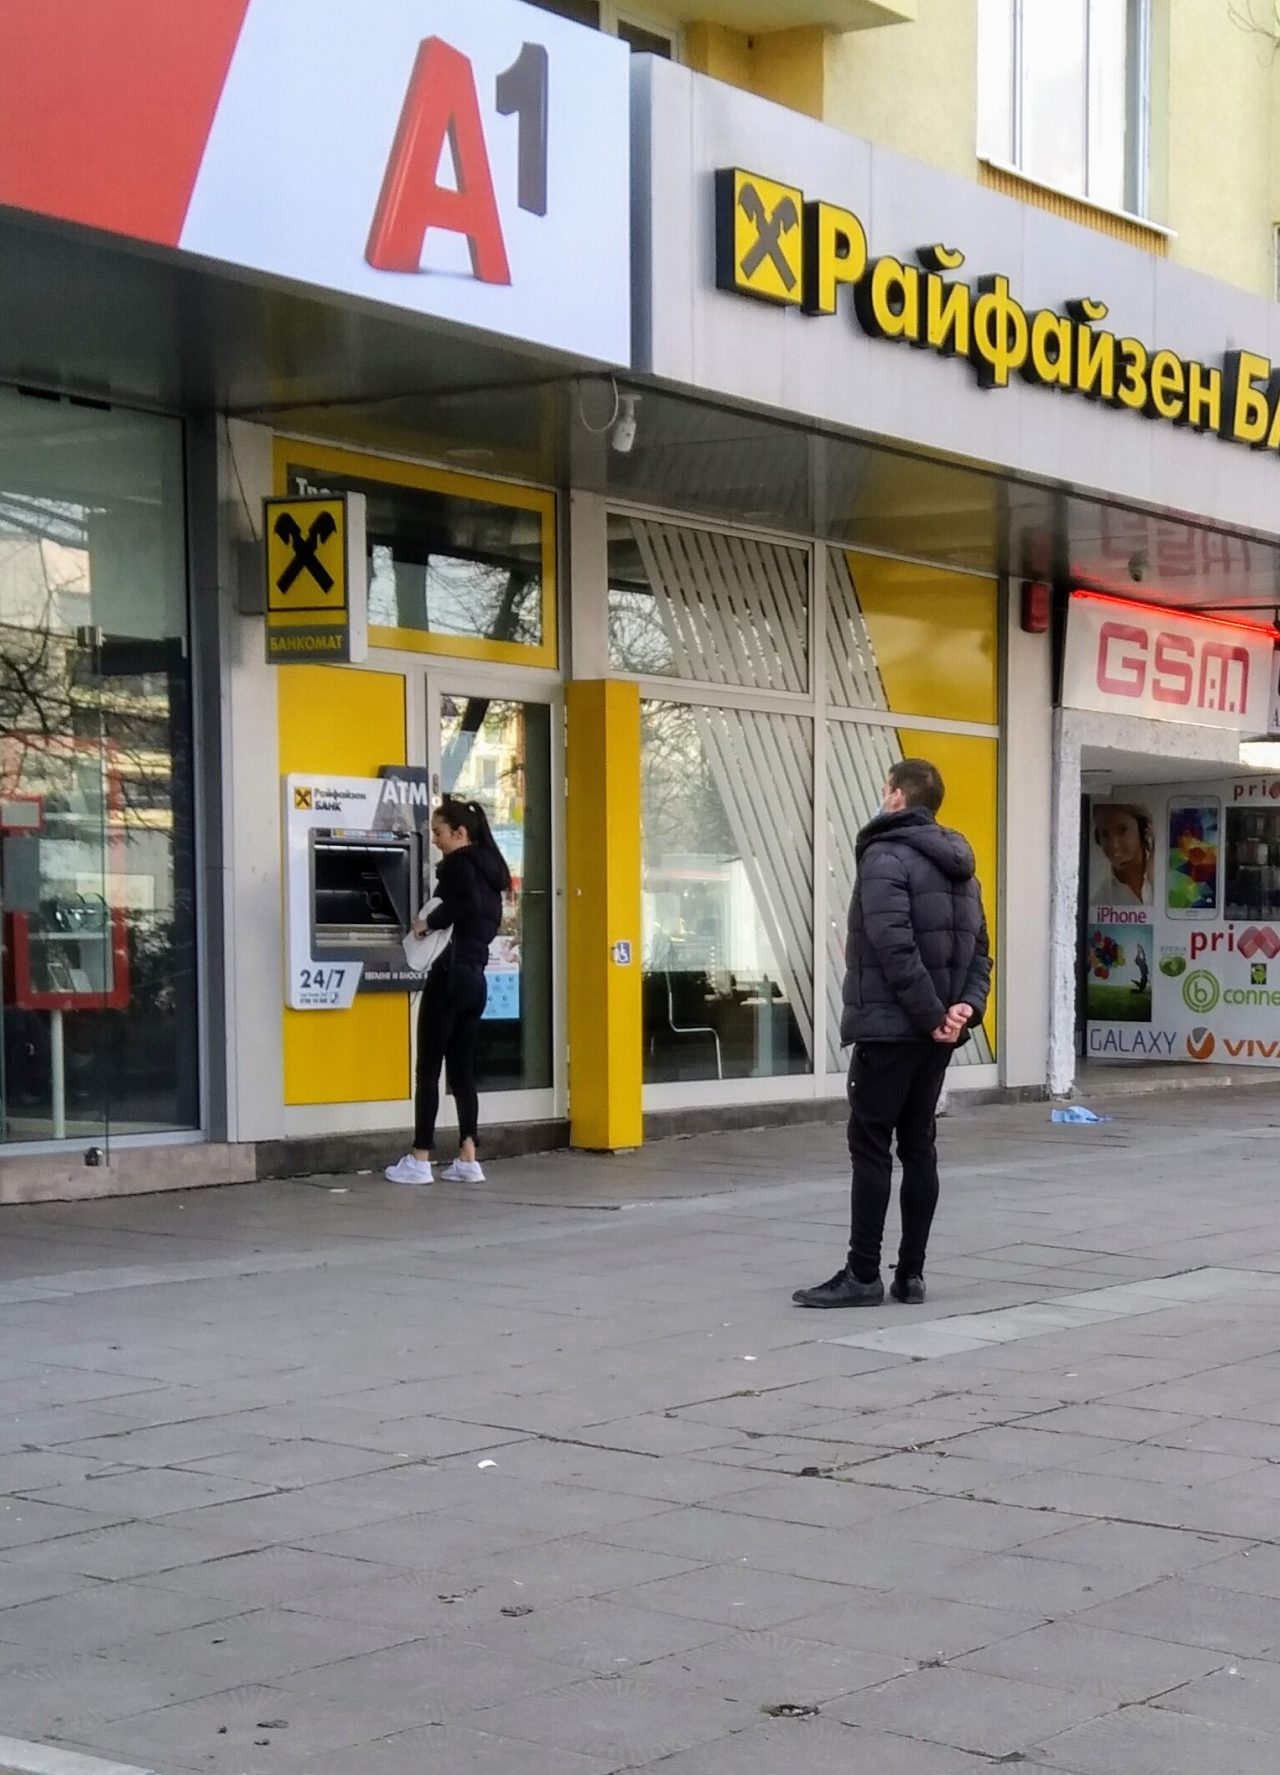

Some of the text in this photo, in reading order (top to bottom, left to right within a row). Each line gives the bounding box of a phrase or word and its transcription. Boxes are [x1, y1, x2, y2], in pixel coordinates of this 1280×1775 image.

[364, 34, 549, 287] A1
[808, 200, 1222, 433] Райфайзен
[269, 635, 342, 651] БАНКОМАТ
[1096, 621, 1249, 715] GSM
[315, 800, 342, 812] БАНК
[383, 781, 428, 806] ATM
[1097, 907, 1147, 924] iPhone
[300, 968, 345, 990] 24/7
[1090, 1028, 1177, 1054] GALAXY
